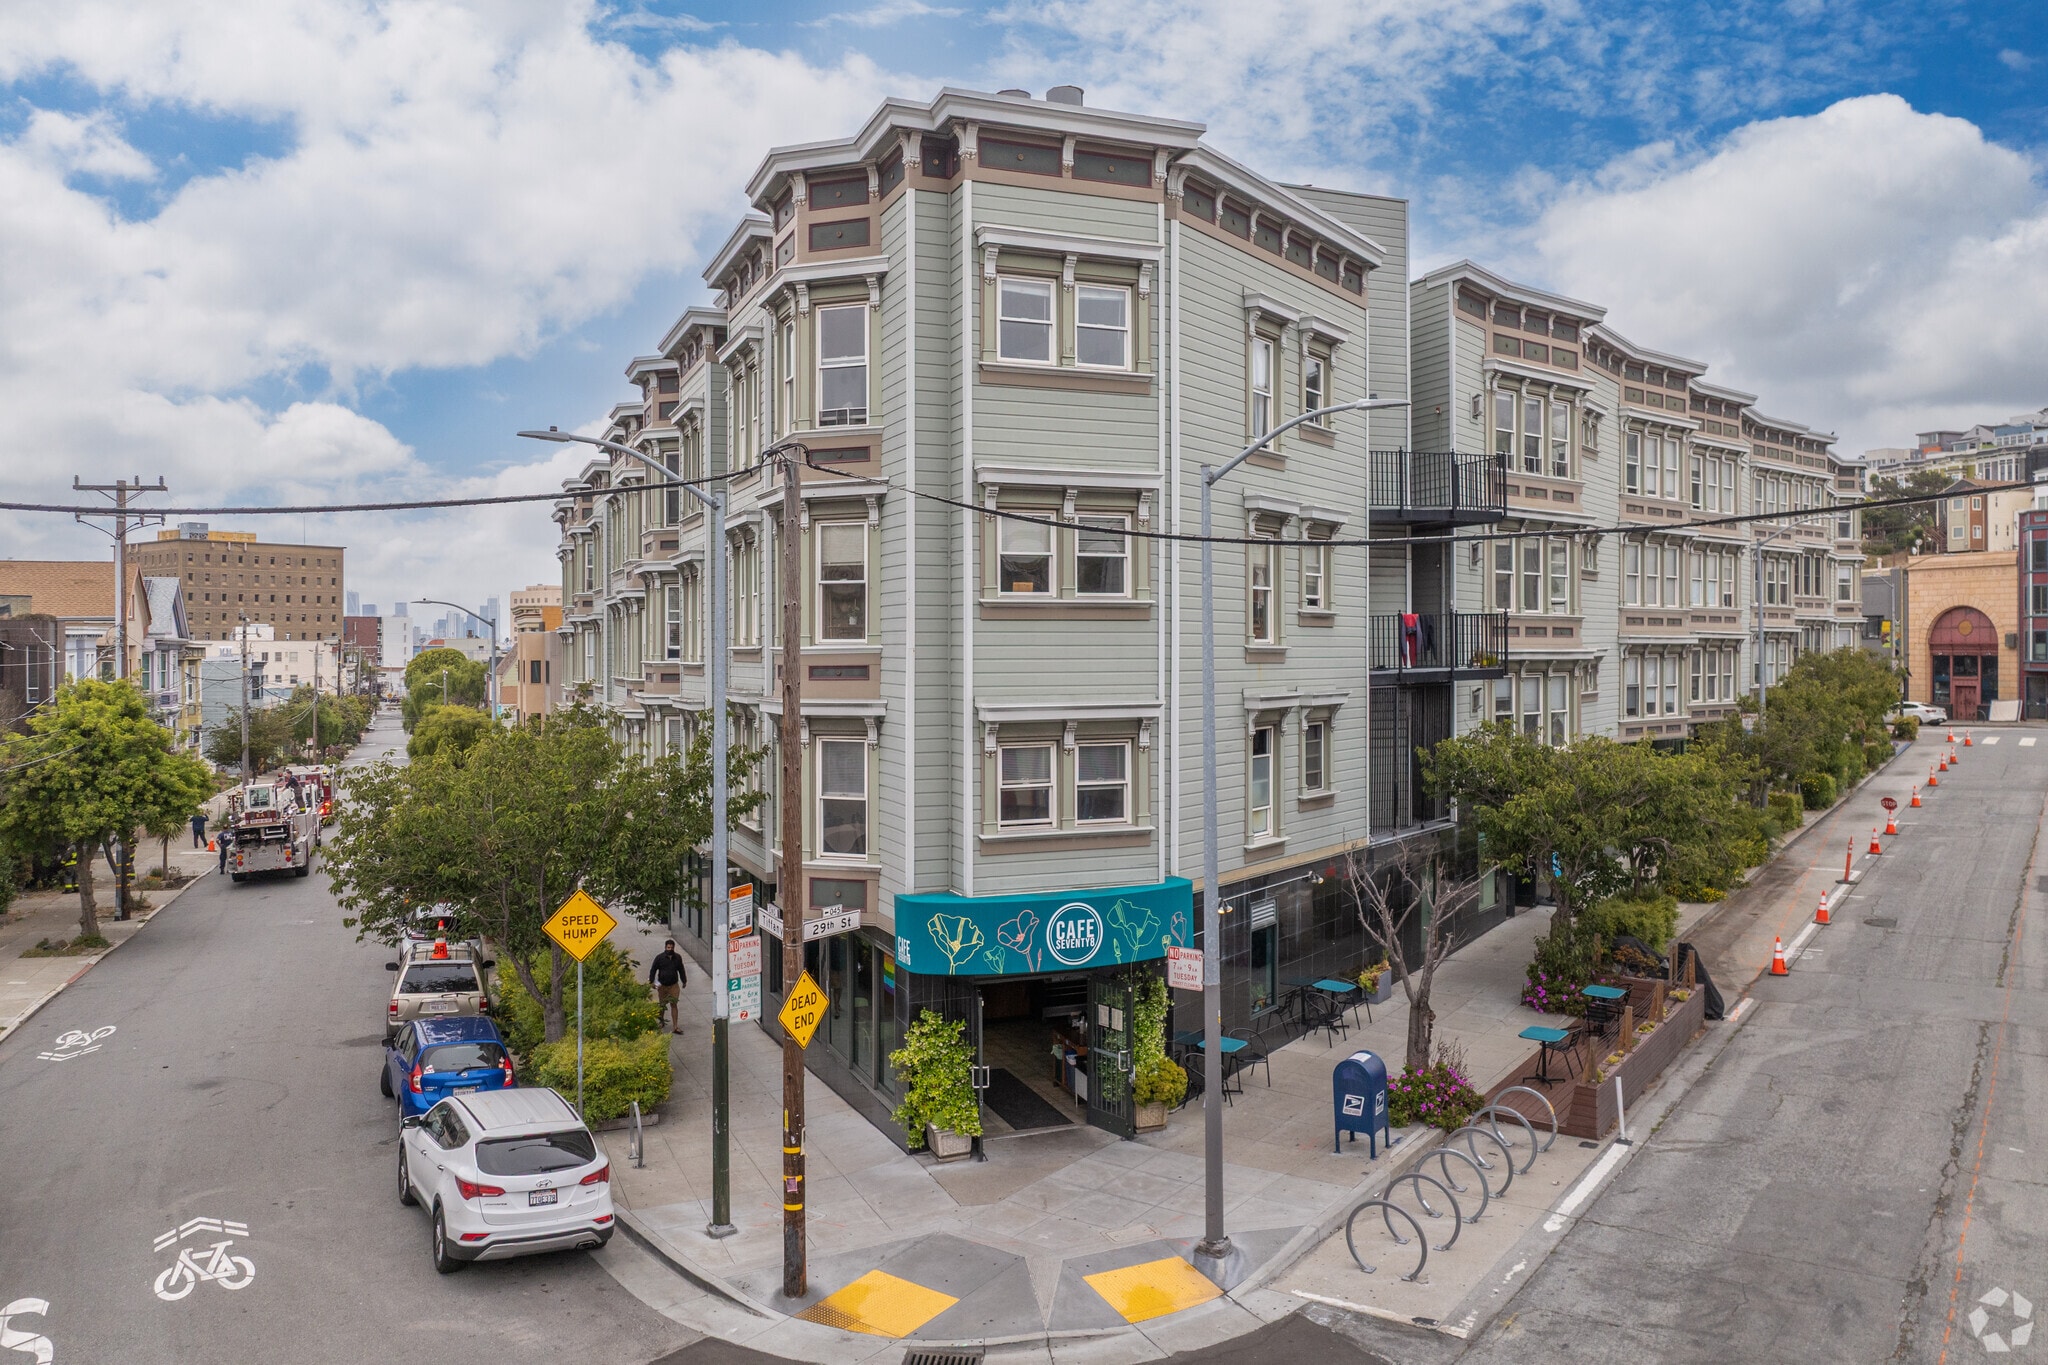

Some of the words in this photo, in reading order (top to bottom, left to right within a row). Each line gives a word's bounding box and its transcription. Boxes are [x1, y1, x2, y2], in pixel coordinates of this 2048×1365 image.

[562, 915, 599, 926] SPEED
[812, 921, 835, 936] 29th
[841, 916, 852, 928] St
[563, 928, 598, 939] HUMP
[1056, 919, 1095, 940] CAFE
[730, 940, 739, 952] NO
[740, 939, 760, 950] PARKING
[1056, 937, 1095, 950] SEVENTY8
[1170, 948, 1179, 959] NO
[1180, 952, 1201, 961] PARKING
[734, 961, 756, 970] TUESDAY
[1174, 973, 1197, 982] TUESDAY
[731, 979, 739, 990] 2
[791, 992, 817, 1011] DEAD
[794, 1012, 815, 1030] END
